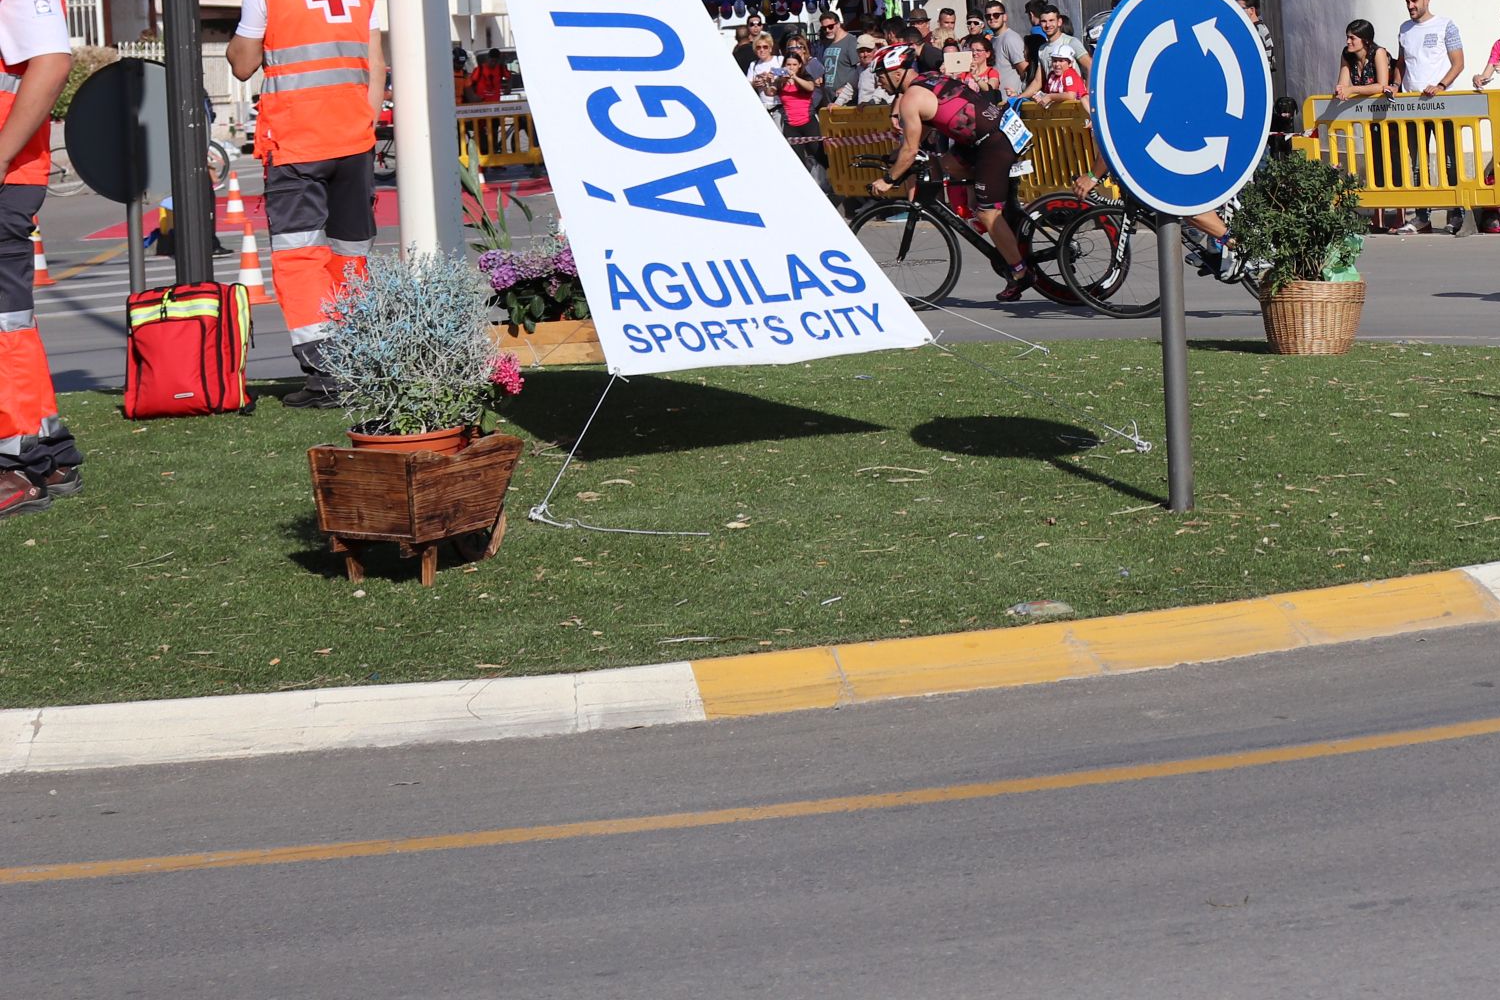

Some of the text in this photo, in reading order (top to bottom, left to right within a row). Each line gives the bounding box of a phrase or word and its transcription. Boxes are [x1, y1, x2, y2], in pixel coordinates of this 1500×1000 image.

[1406, 103, 1416, 111] DE
[1417, 102, 1446, 111] AGUILAS
[1006, 119, 1023, 137] 132C
[605, 249, 866, 311] ÁGUILAS
[623, 303, 885, 354] SPORT'S CITY
